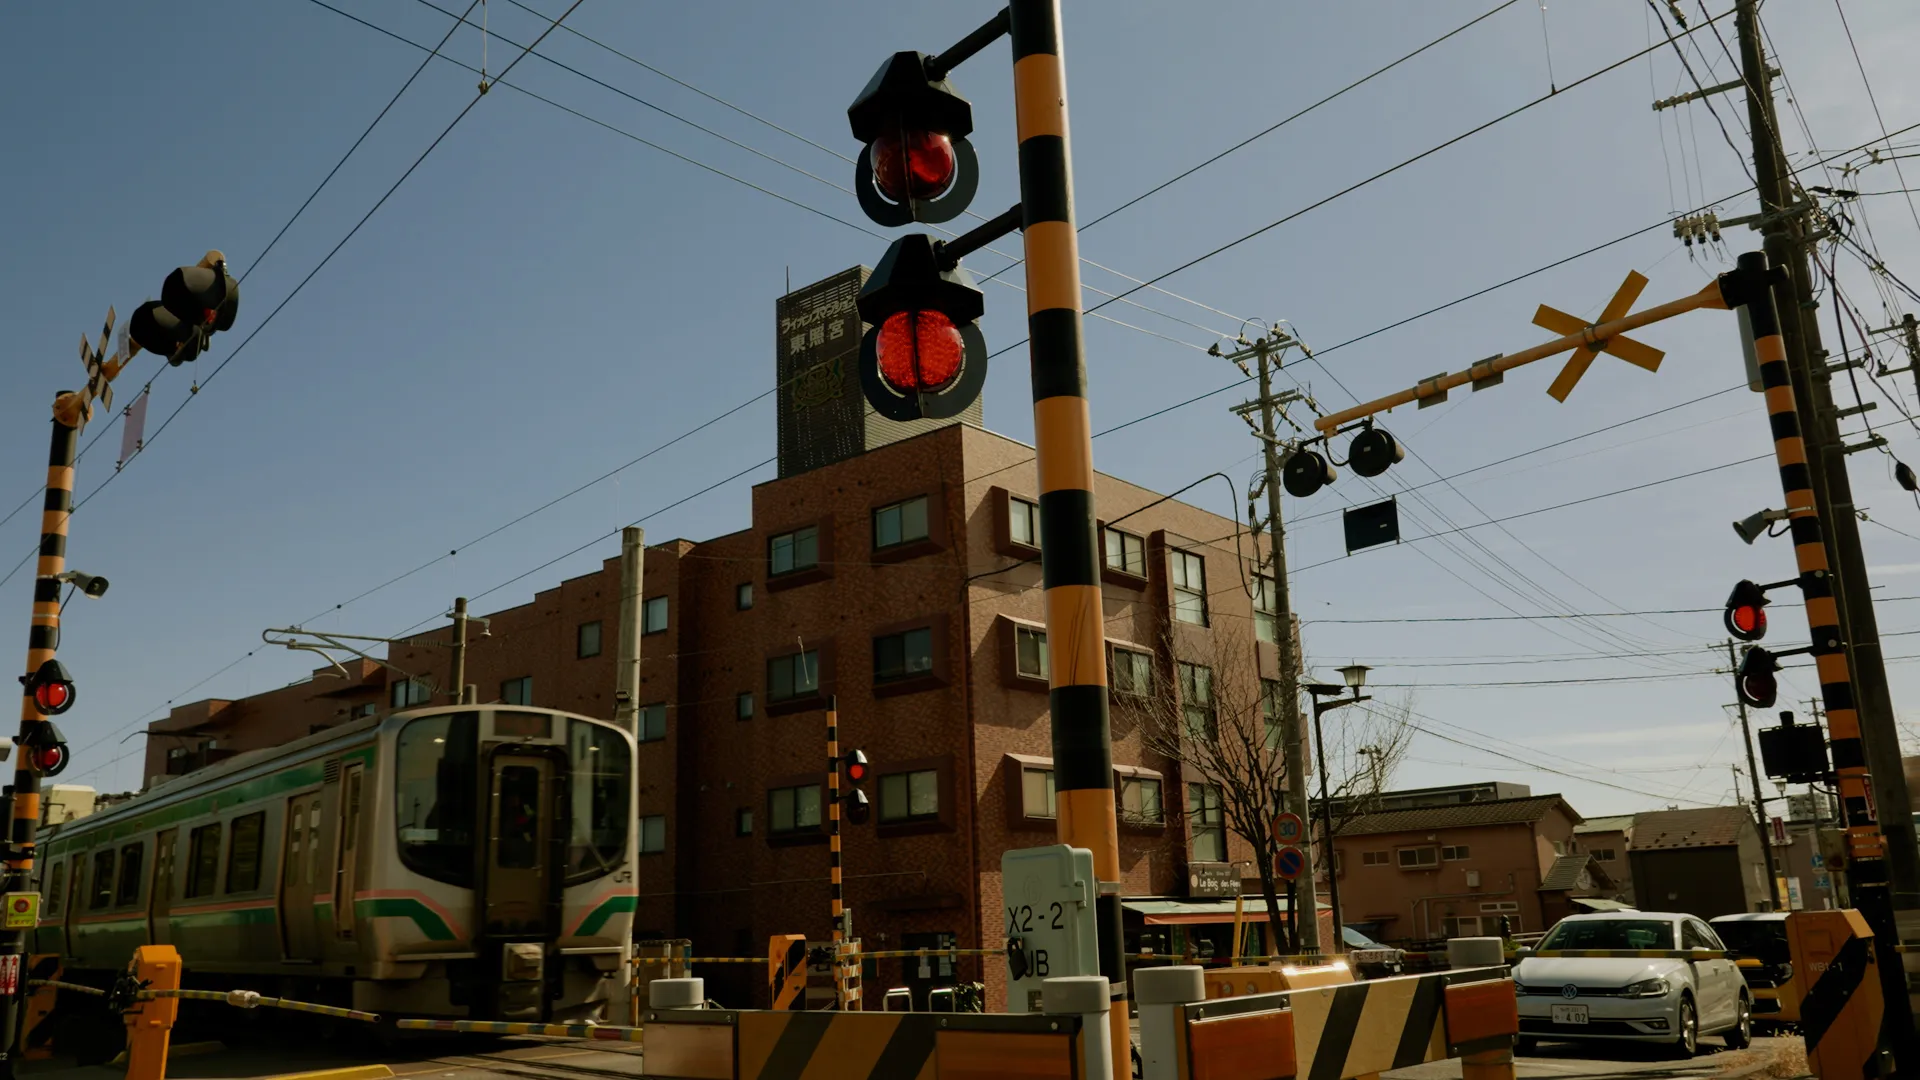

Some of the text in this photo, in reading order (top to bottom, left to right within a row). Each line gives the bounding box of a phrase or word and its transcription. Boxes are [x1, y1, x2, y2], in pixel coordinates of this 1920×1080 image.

[790, 318, 845, 355] 東照宮
[1279, 821, 1296, 836] 30
[1008, 901, 1064, 933] X2-2
